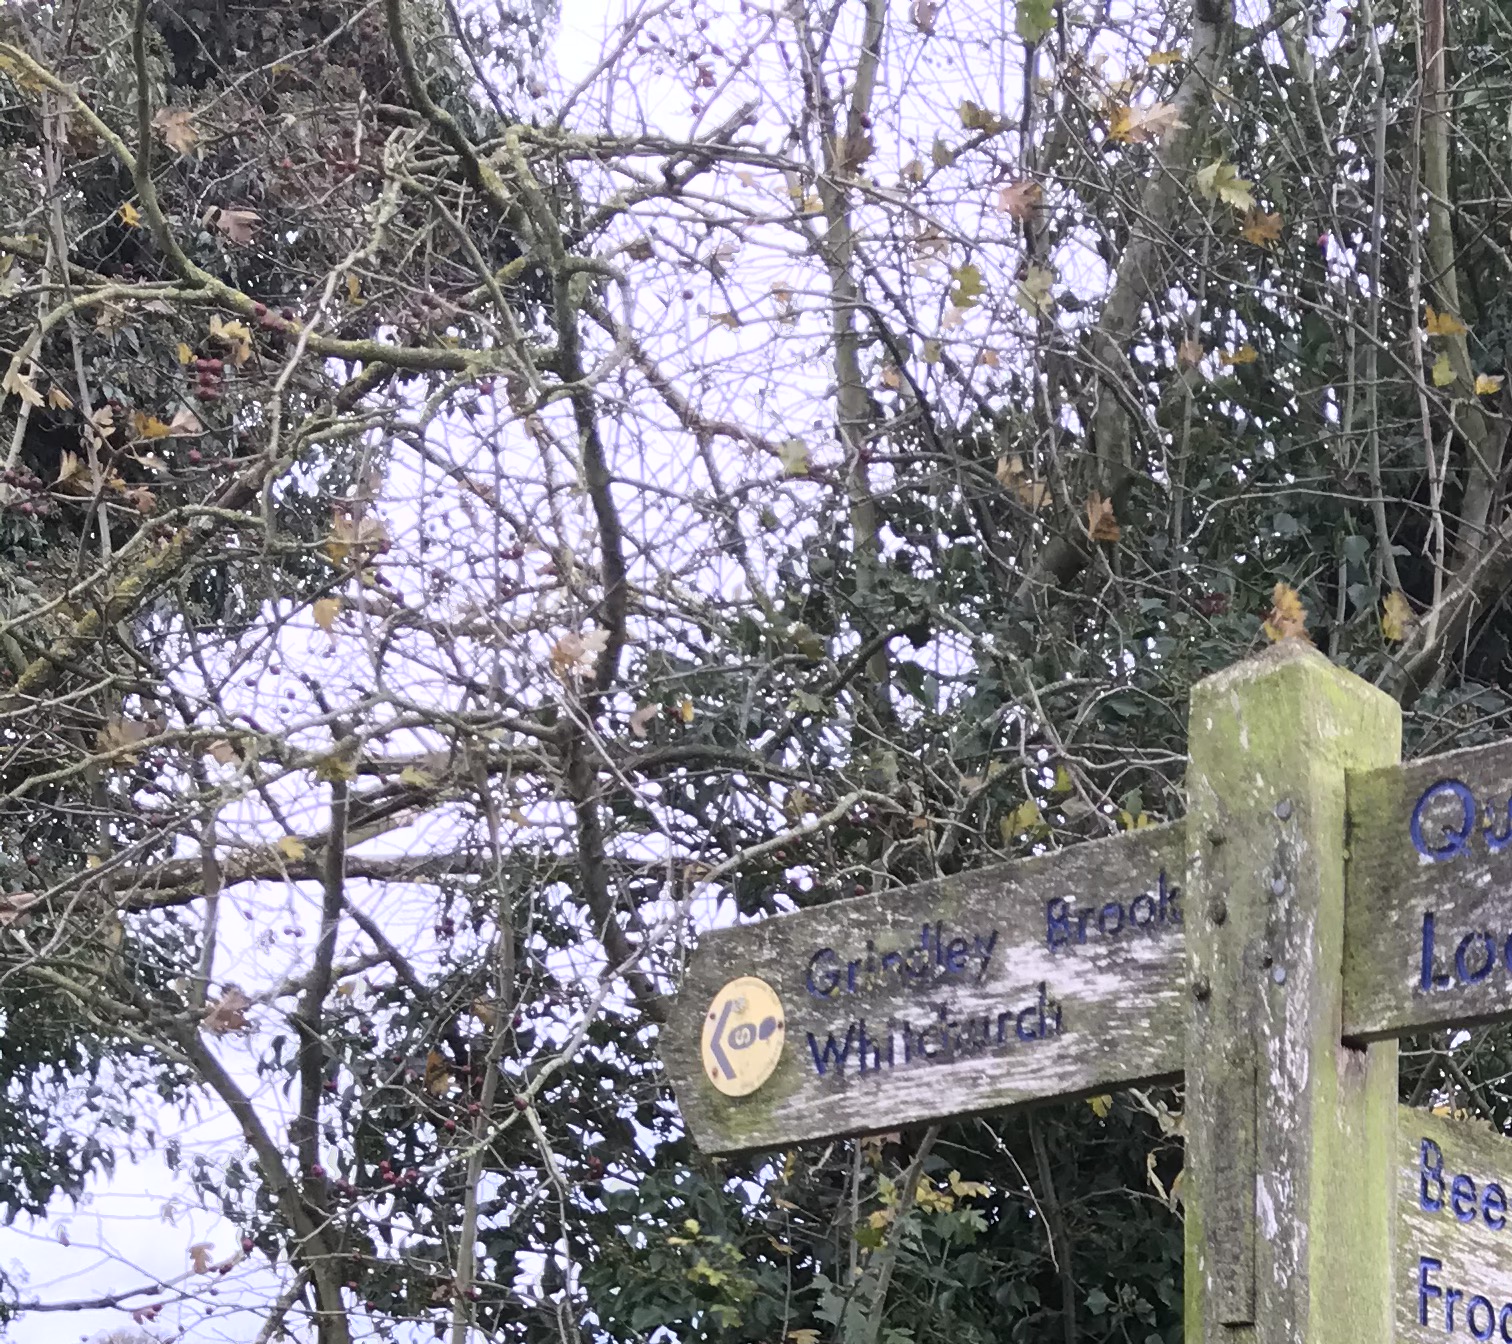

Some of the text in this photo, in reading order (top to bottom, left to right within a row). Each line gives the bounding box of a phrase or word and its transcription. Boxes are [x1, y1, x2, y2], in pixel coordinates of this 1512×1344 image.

[806, 867, 1184, 1001] Grindley Brook
[807, 981, 1062, 1075] Whitchurch
